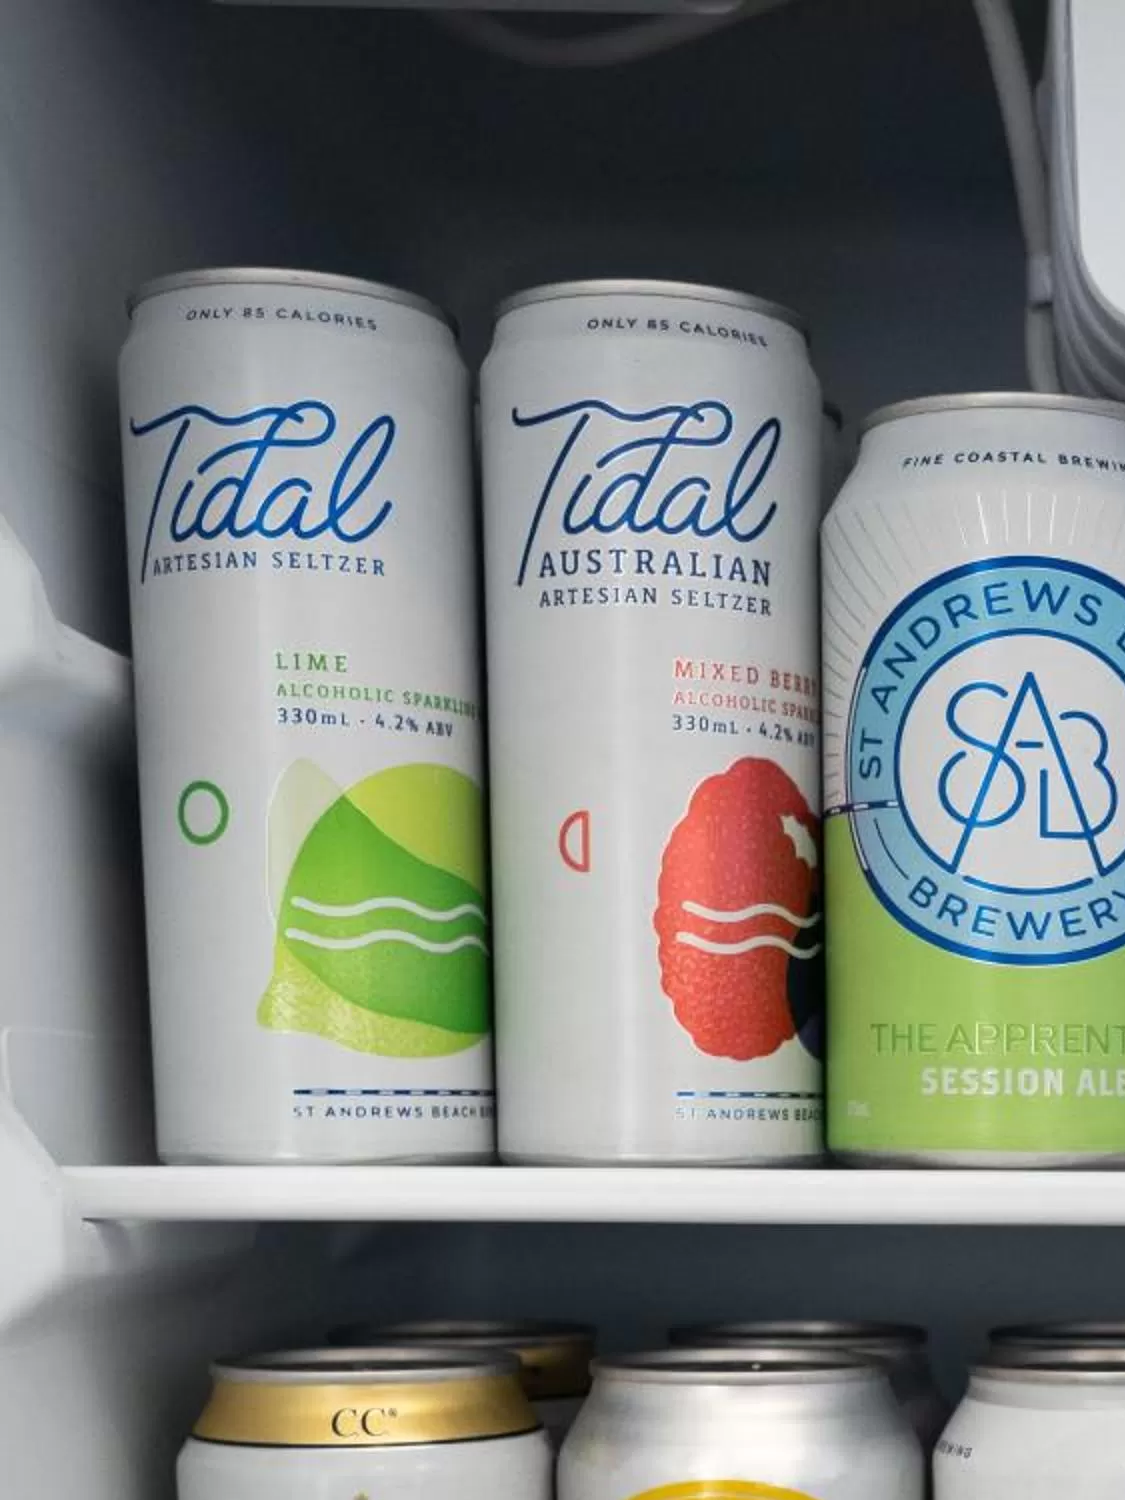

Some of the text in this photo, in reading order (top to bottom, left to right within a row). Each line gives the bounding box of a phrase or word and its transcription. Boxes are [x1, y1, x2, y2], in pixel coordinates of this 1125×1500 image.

[186, 307, 377, 331] ONLY 85 CALORIES
[587, 318, 638, 330] ONLY
[679, 322, 768, 348] CALORIES
[903, 454, 944, 469] FINE
[954, 451, 1047, 464] COASTAL
[130, 400, 396, 584] Tidal
[512, 399, 782, 587] Tidal
[153, 551, 385, 576] ARTESIAN SELTZER
[540, 550, 772, 587] AUSTRALIAN
[540, 587, 772, 616] ARTESIAN SELTZER
[276, 653, 348, 672] LIME
[675, 659, 759, 685] MIXED
[859, 730, 883, 780] ST
[871, 579, 1103, 714] ANDREWS
[277, 683, 393, 703] ALCOHOLIC
[674, 691, 776, 713] ALCOHOLIC
[277, 708, 453, 737] 330mL 4.2% ABV
[672, 714, 738, 735] 330mL
[871, 1023, 937, 1057] THE
[922, 1067, 1063, 1096] SESSION
[293, 1106, 314, 1119] ST
[325, 1106, 423, 1119] ANDREWS
[432, 1106, 478, 1119] BEACH
[706, 1108, 789, 1121] ANDREWS
